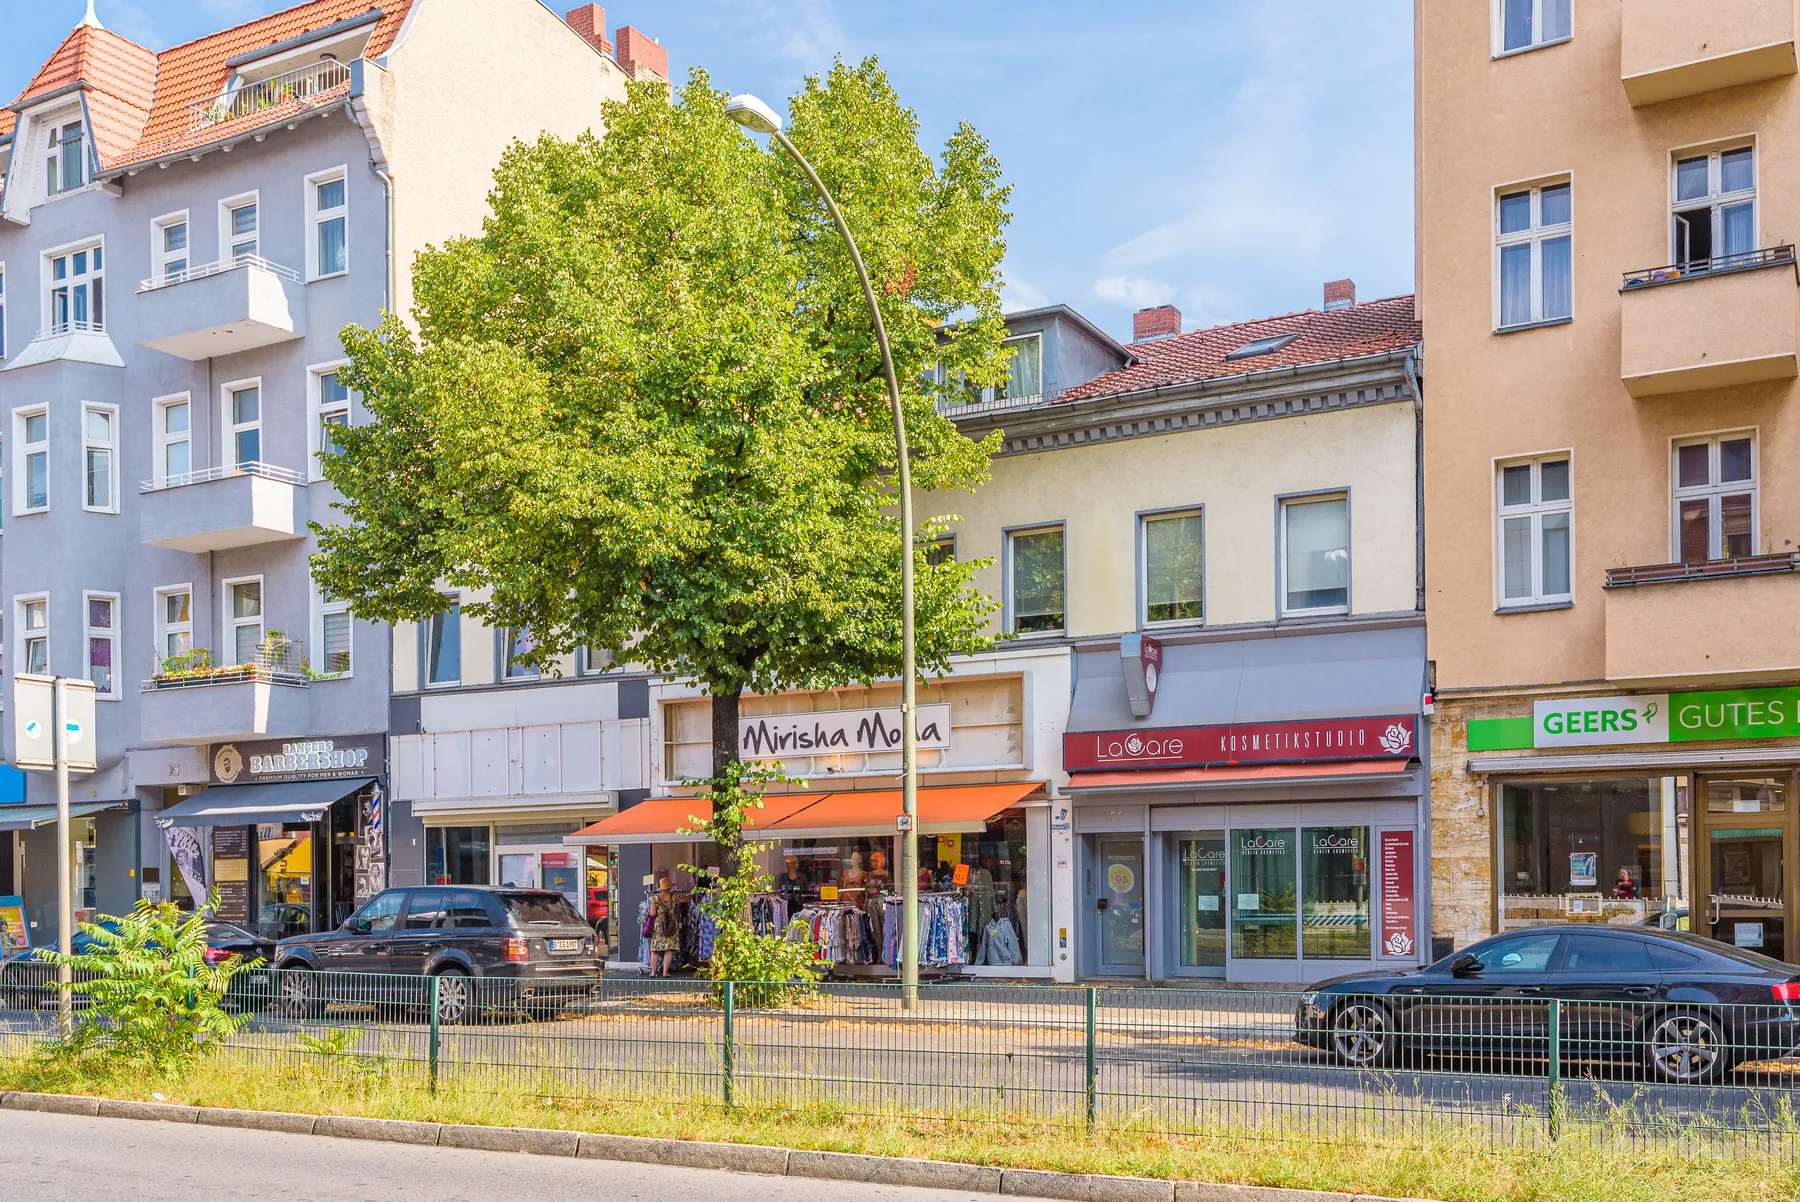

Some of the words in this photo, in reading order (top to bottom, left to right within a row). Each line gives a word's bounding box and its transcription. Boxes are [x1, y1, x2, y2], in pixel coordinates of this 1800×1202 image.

[1543, 708, 1638, 734] GEERS
[1679, 700, 1784, 729] GUTES
[743, 719, 849, 755] Mirisha
[856, 712, 942, 748] Moa
[1221, 729, 1365, 752] KOSMETIKSTUDIO
[282, 740, 334, 755] RANGERS
[1097, 733, 1183, 758] LaCare
[250, 749, 368, 773] BARBERSHOP
[1241, 836, 1285, 848] LaCare
[1313, 834, 1359, 847] LaCare
[1184, 848, 1225, 859] LaCare
